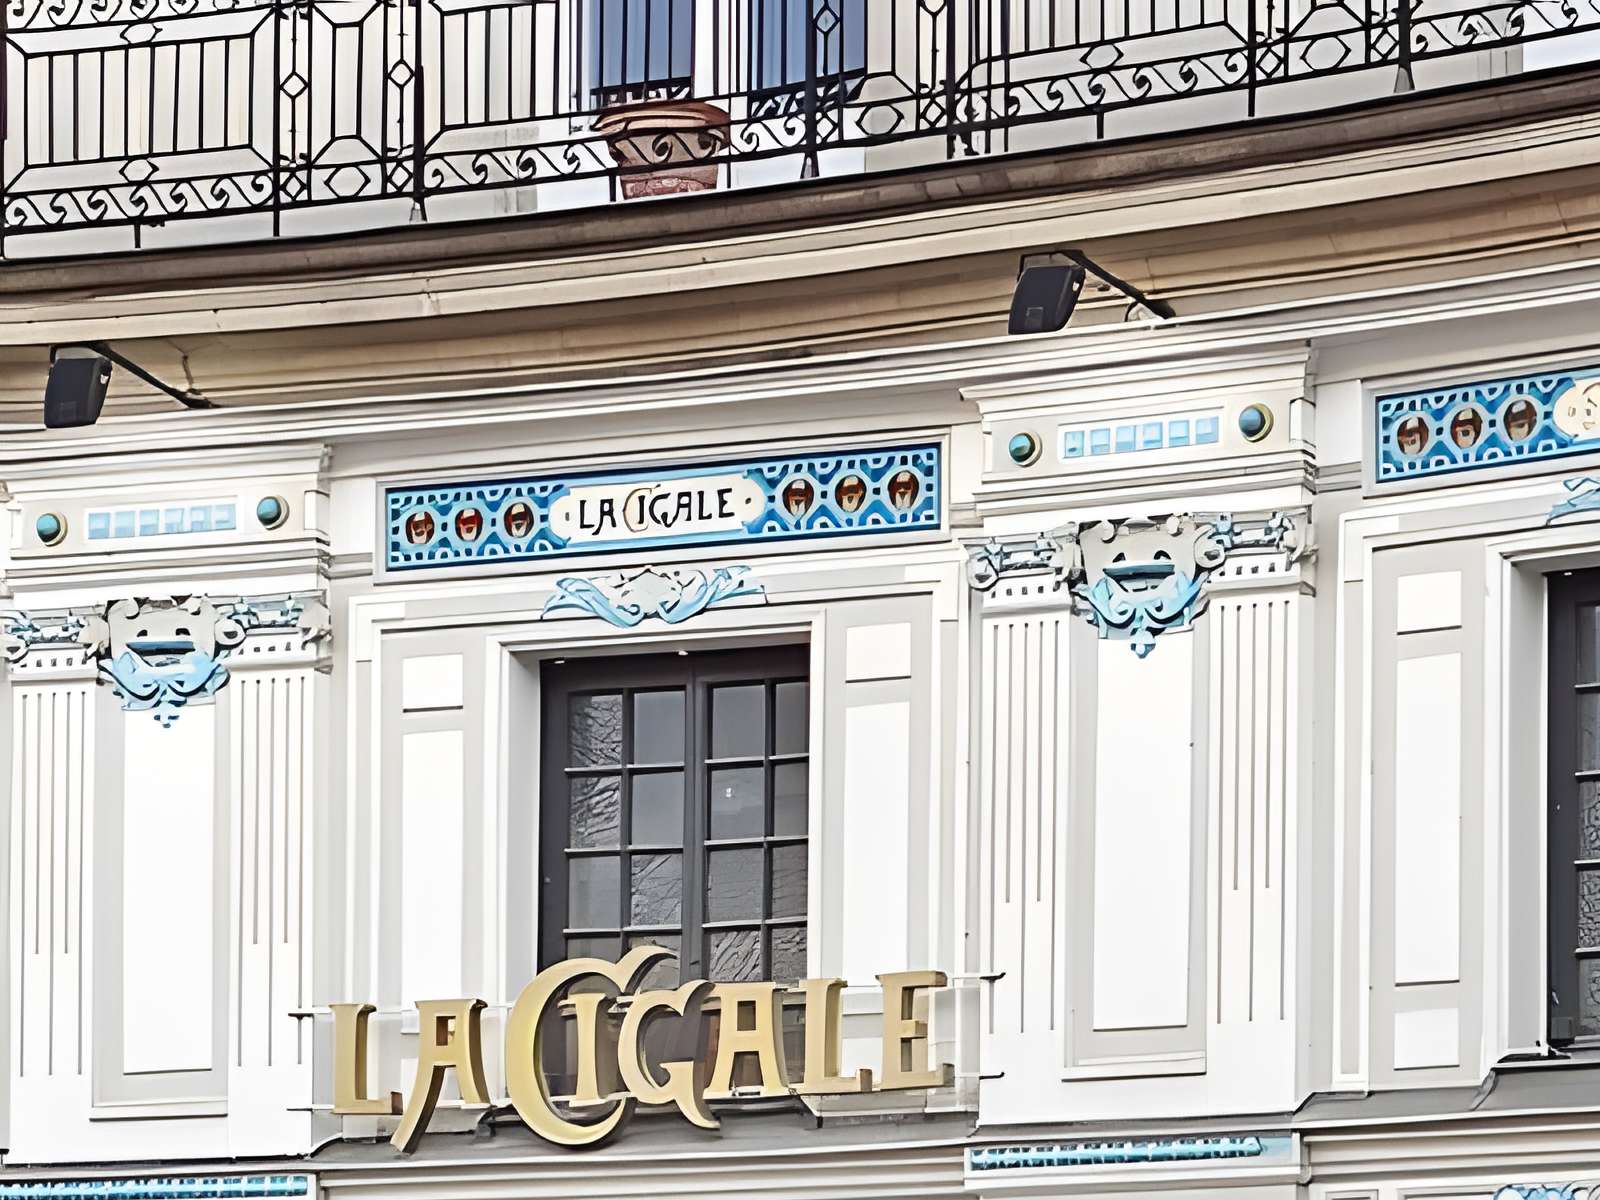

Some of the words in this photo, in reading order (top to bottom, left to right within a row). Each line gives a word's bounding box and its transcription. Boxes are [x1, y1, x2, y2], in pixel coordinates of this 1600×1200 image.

[579, 498, 617, 536] LA
[622, 483, 736, 533] CIGALE
[330, 998, 491, 1154] LA
[505, 944, 953, 1148] CIGALE
